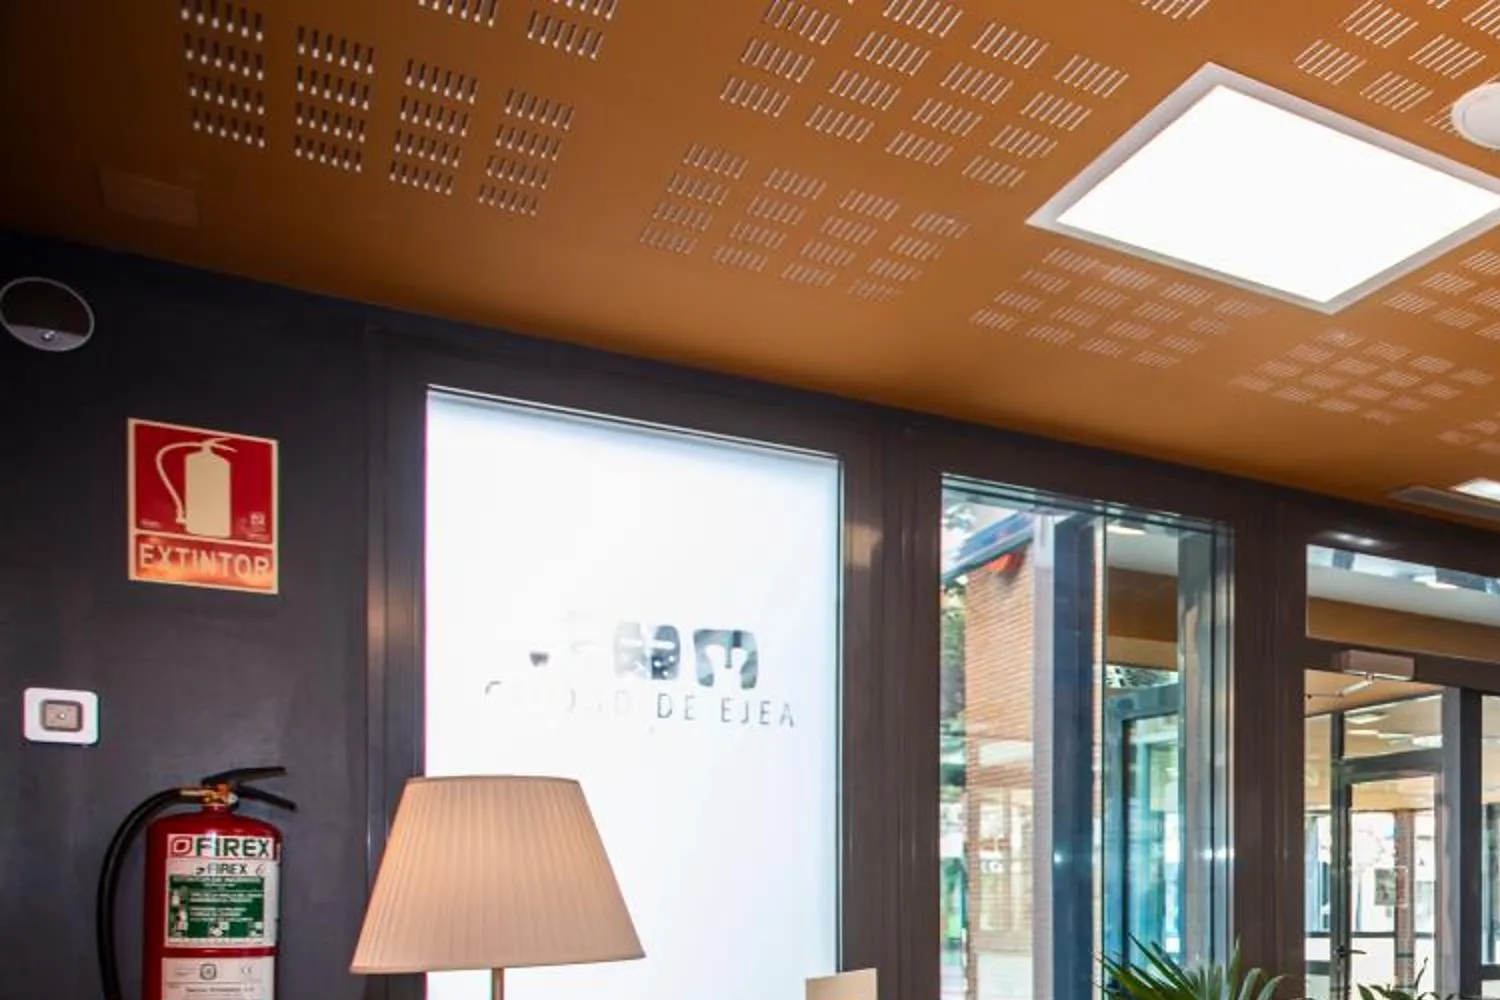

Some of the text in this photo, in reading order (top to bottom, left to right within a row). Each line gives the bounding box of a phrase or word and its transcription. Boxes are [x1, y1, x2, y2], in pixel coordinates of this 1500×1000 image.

[139, 543, 270, 579] EXTINTOR
[656, 692, 697, 721] DE
[720, 697, 796, 728] EJEA
[196, 837, 269, 857] FIREX
[207, 863, 249, 875] FIREX
